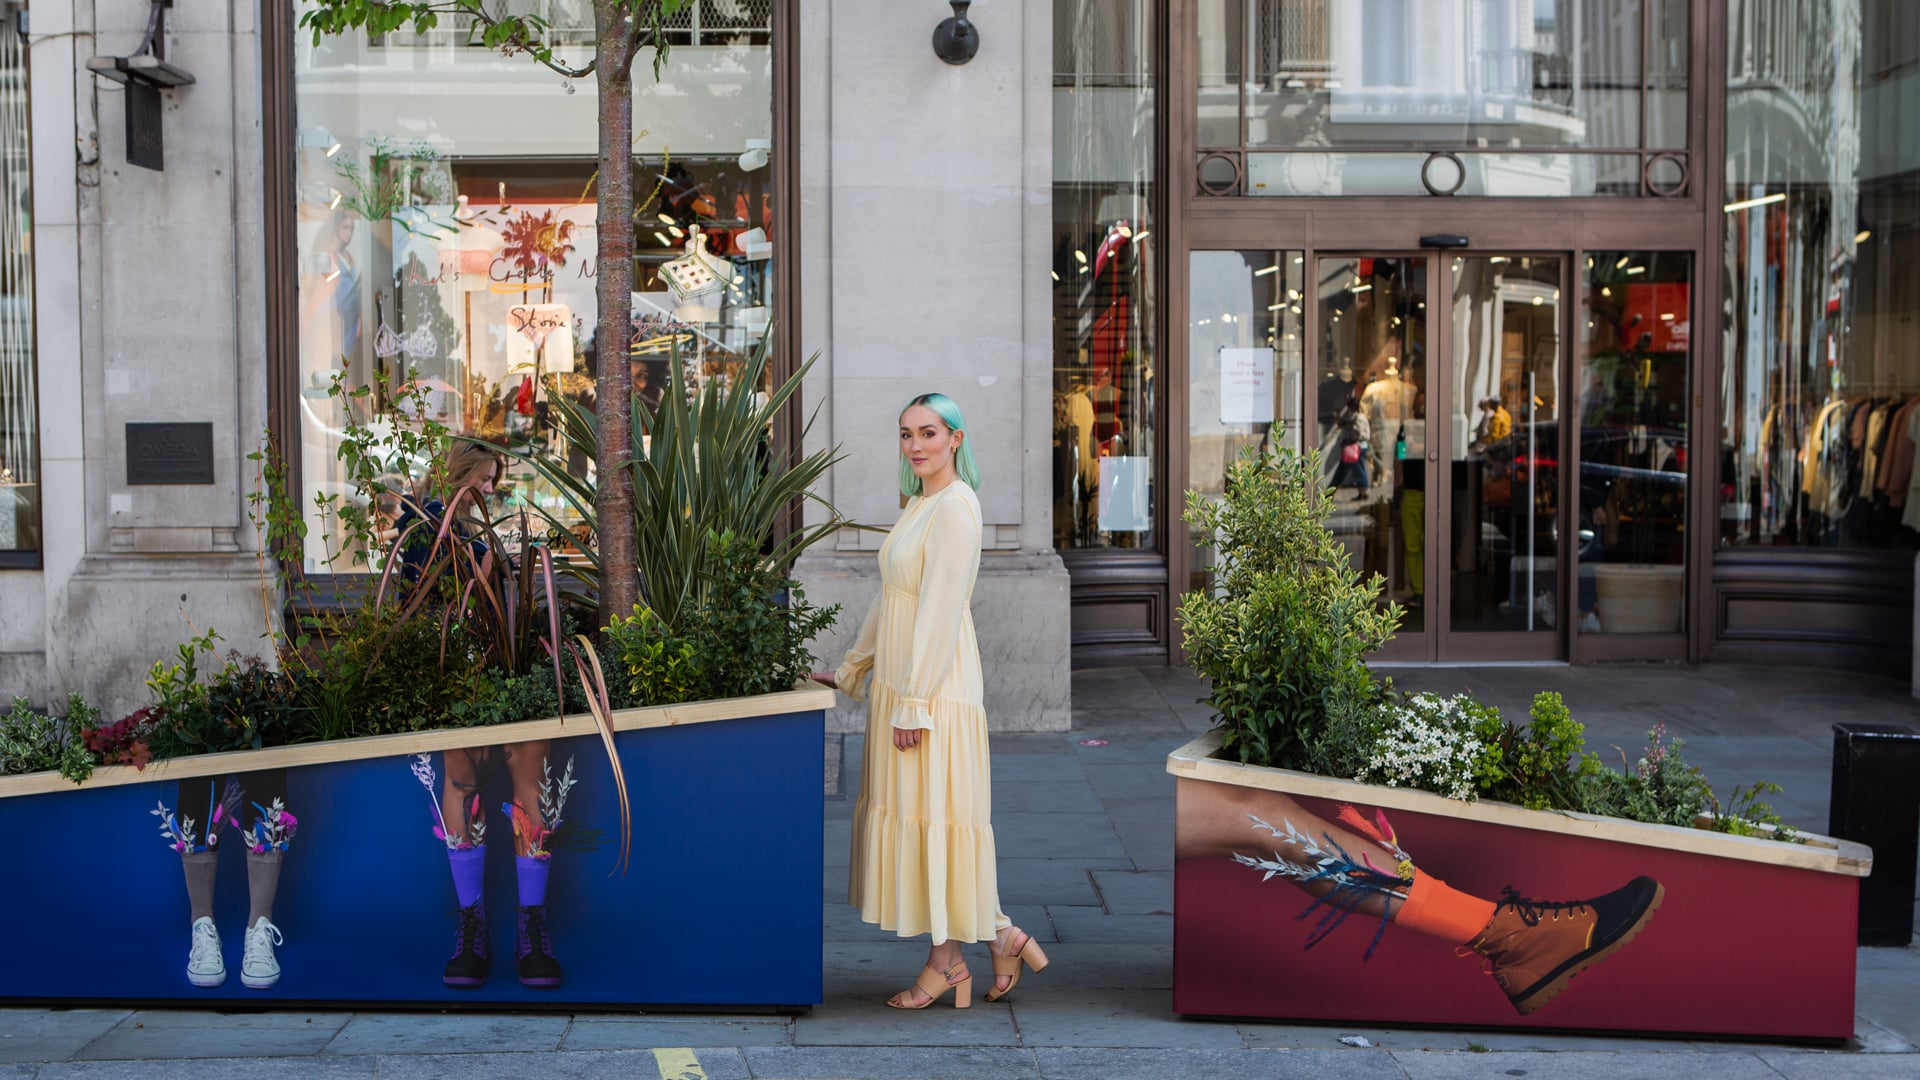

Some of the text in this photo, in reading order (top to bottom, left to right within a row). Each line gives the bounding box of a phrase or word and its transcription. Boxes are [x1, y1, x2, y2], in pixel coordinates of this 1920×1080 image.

[488, 257, 556, 283] Create
[631, 306, 697, 344] gether
[140, 441, 200, 457] OMEGA
[500, 529, 544, 545] othr
